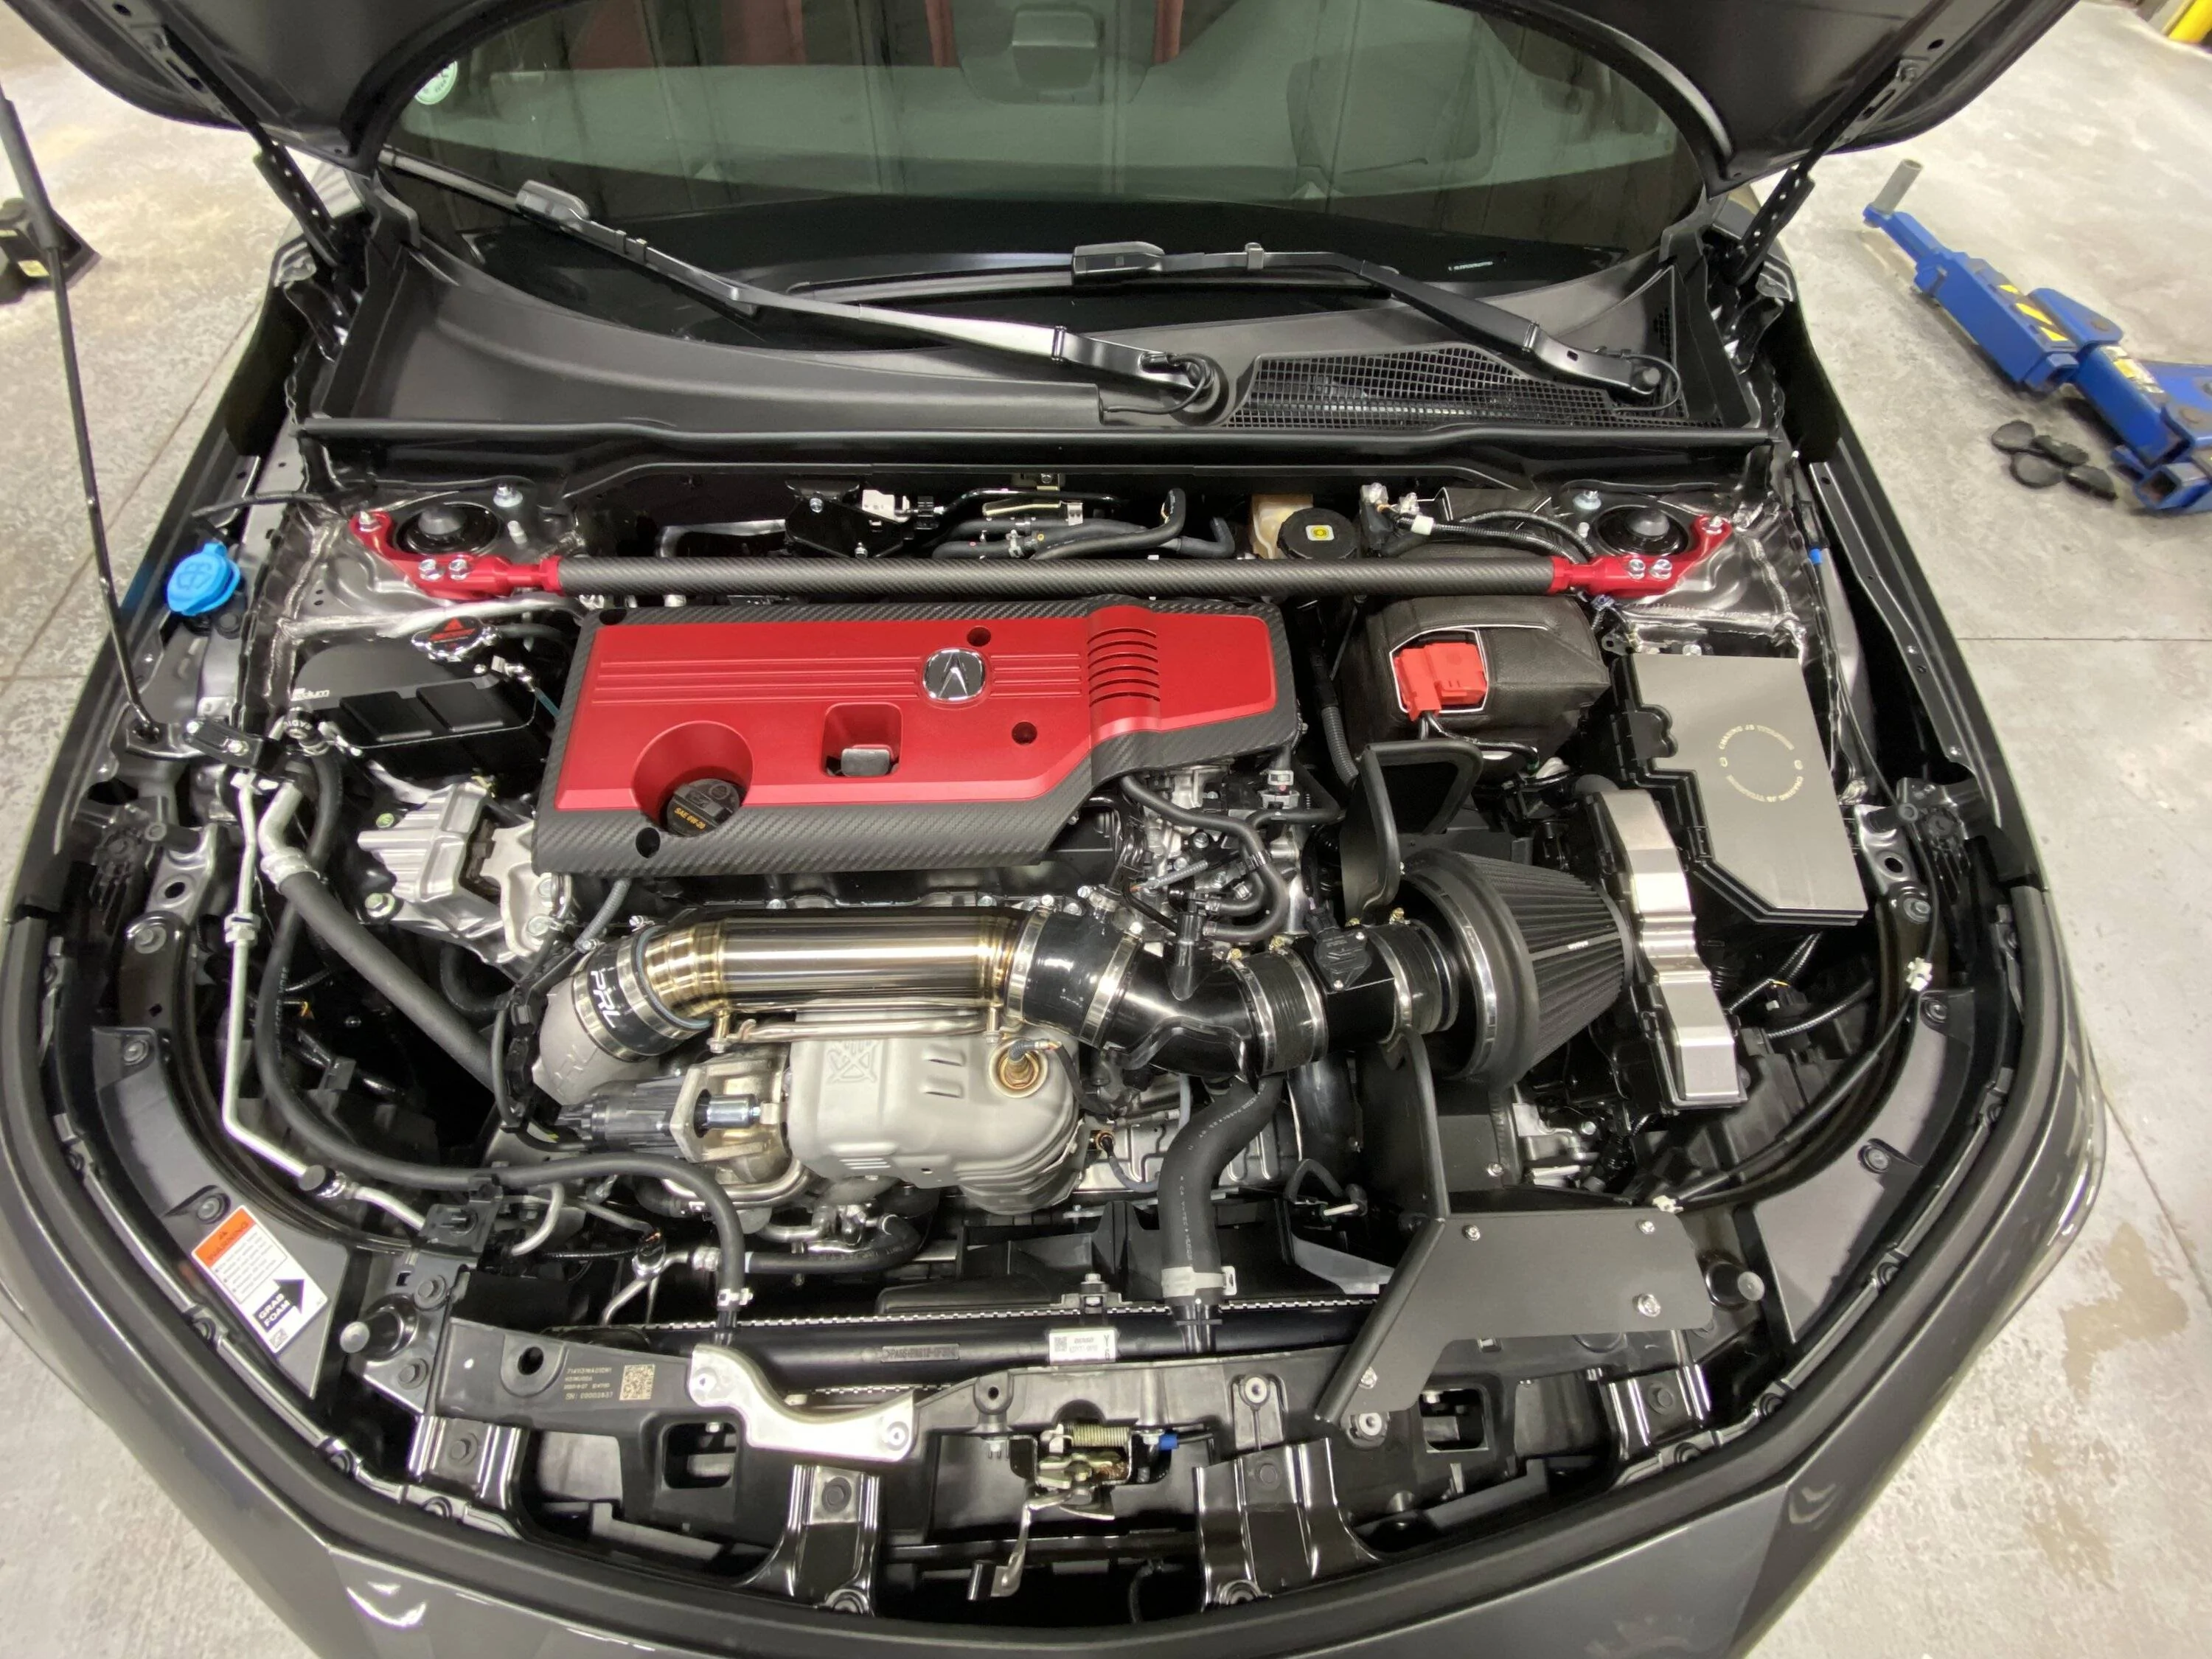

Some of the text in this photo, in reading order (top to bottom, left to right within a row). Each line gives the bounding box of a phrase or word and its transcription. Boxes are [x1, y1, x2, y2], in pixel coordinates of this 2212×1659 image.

[591, 970, 621, 1029] PRL
[207, 1221, 250, 1261] WARNING
[257, 1294, 285, 1320] GRAB
[263, 1301, 291, 1327] FOAM
